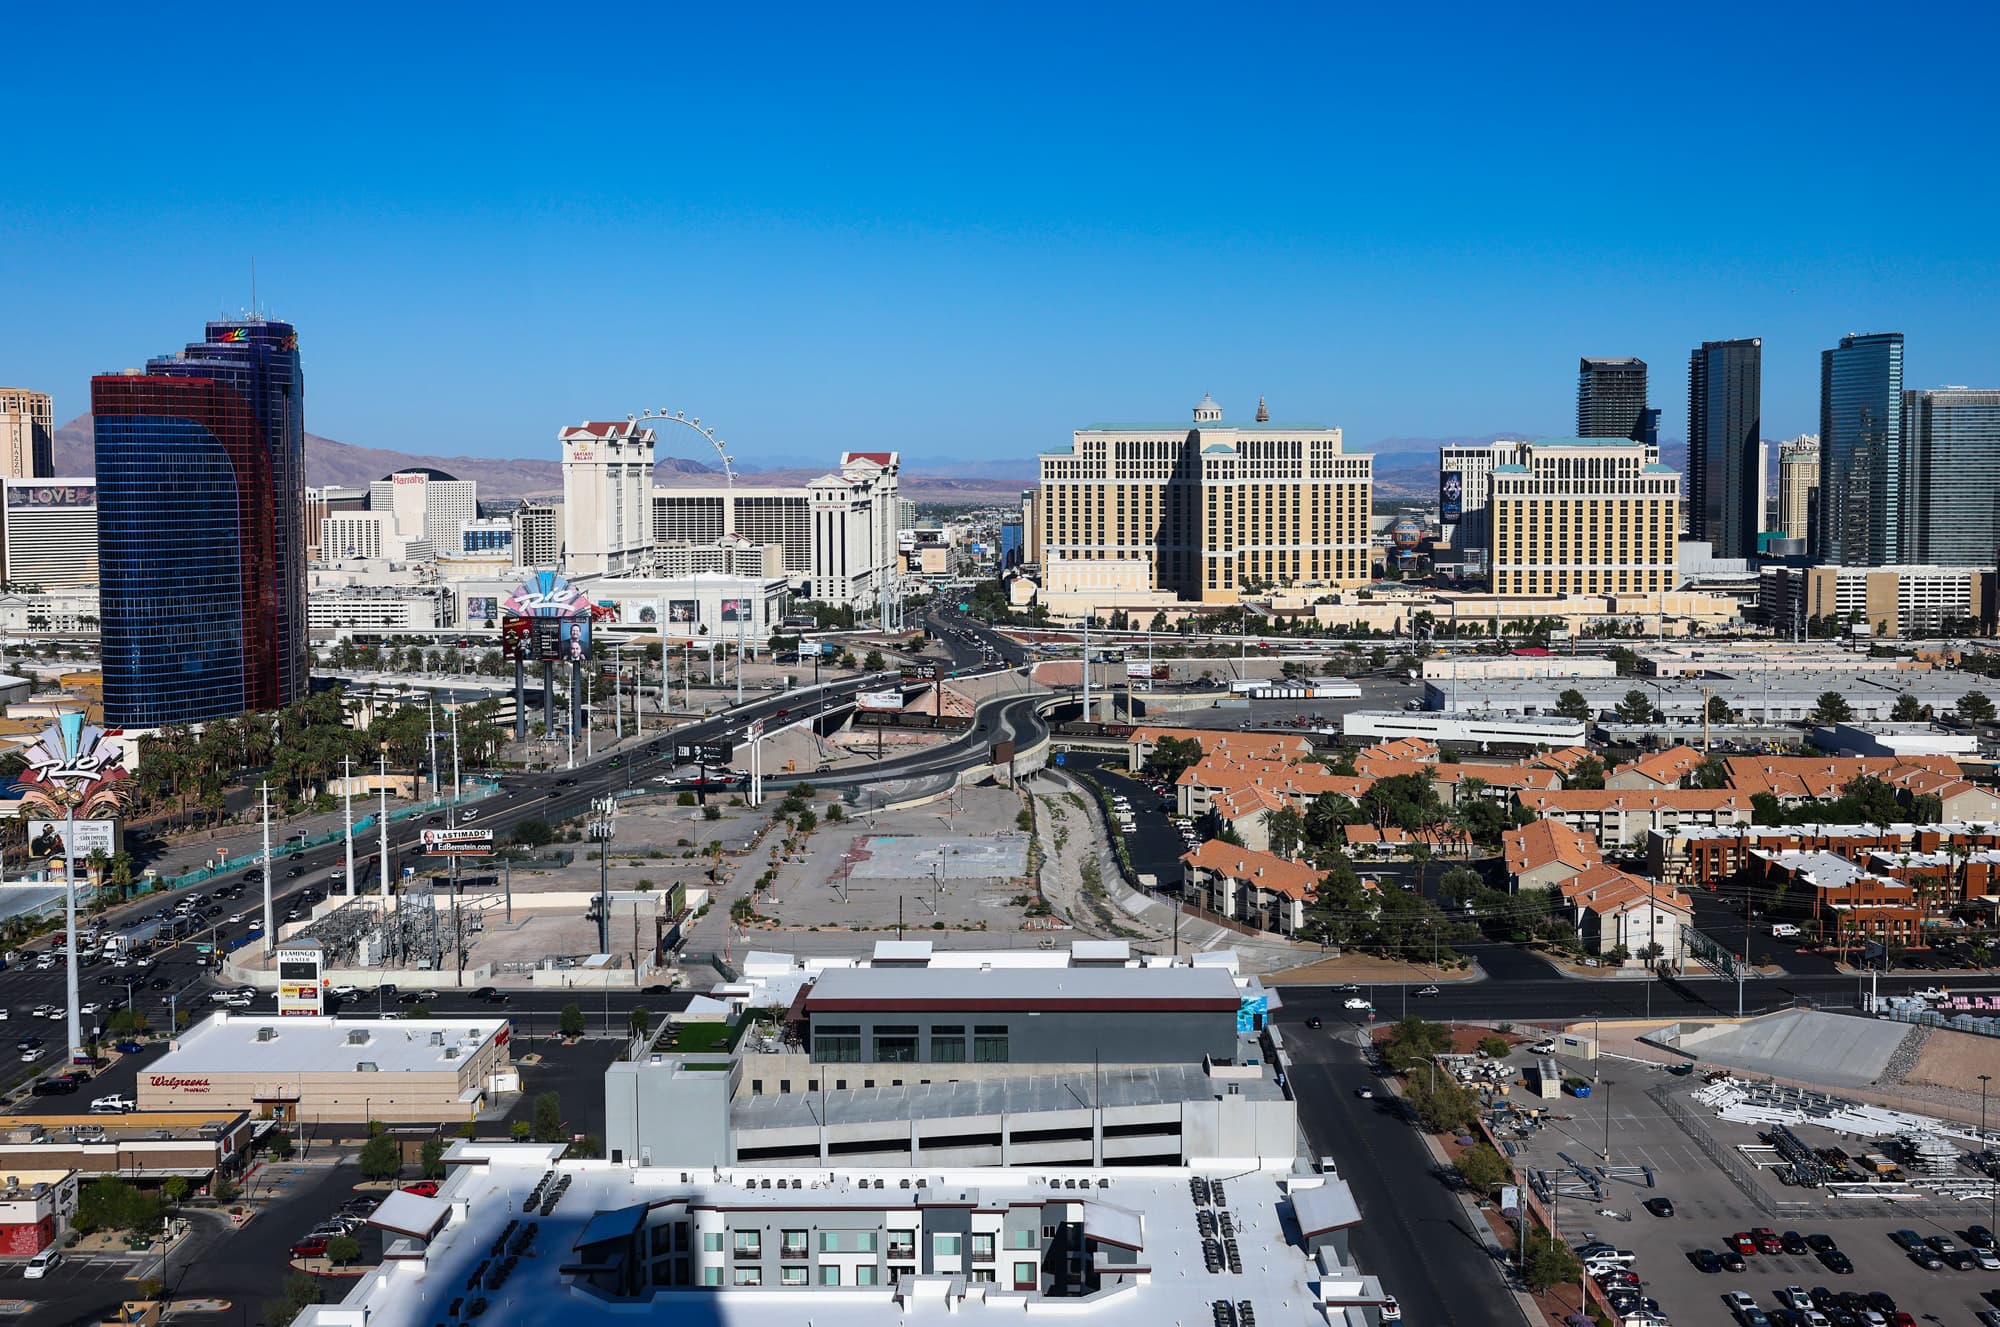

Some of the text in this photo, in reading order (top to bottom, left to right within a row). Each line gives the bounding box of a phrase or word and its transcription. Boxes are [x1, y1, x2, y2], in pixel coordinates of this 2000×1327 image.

[28, 488, 76, 504] LOVE
[514, 586, 576, 612] Rio
[28, 752, 102, 782] Rio
[437, 830, 491, 839] LASTIMADO?
[438, 843, 491, 851] EdBernstein.com
[150, 1075, 210, 1090] Walgreens
